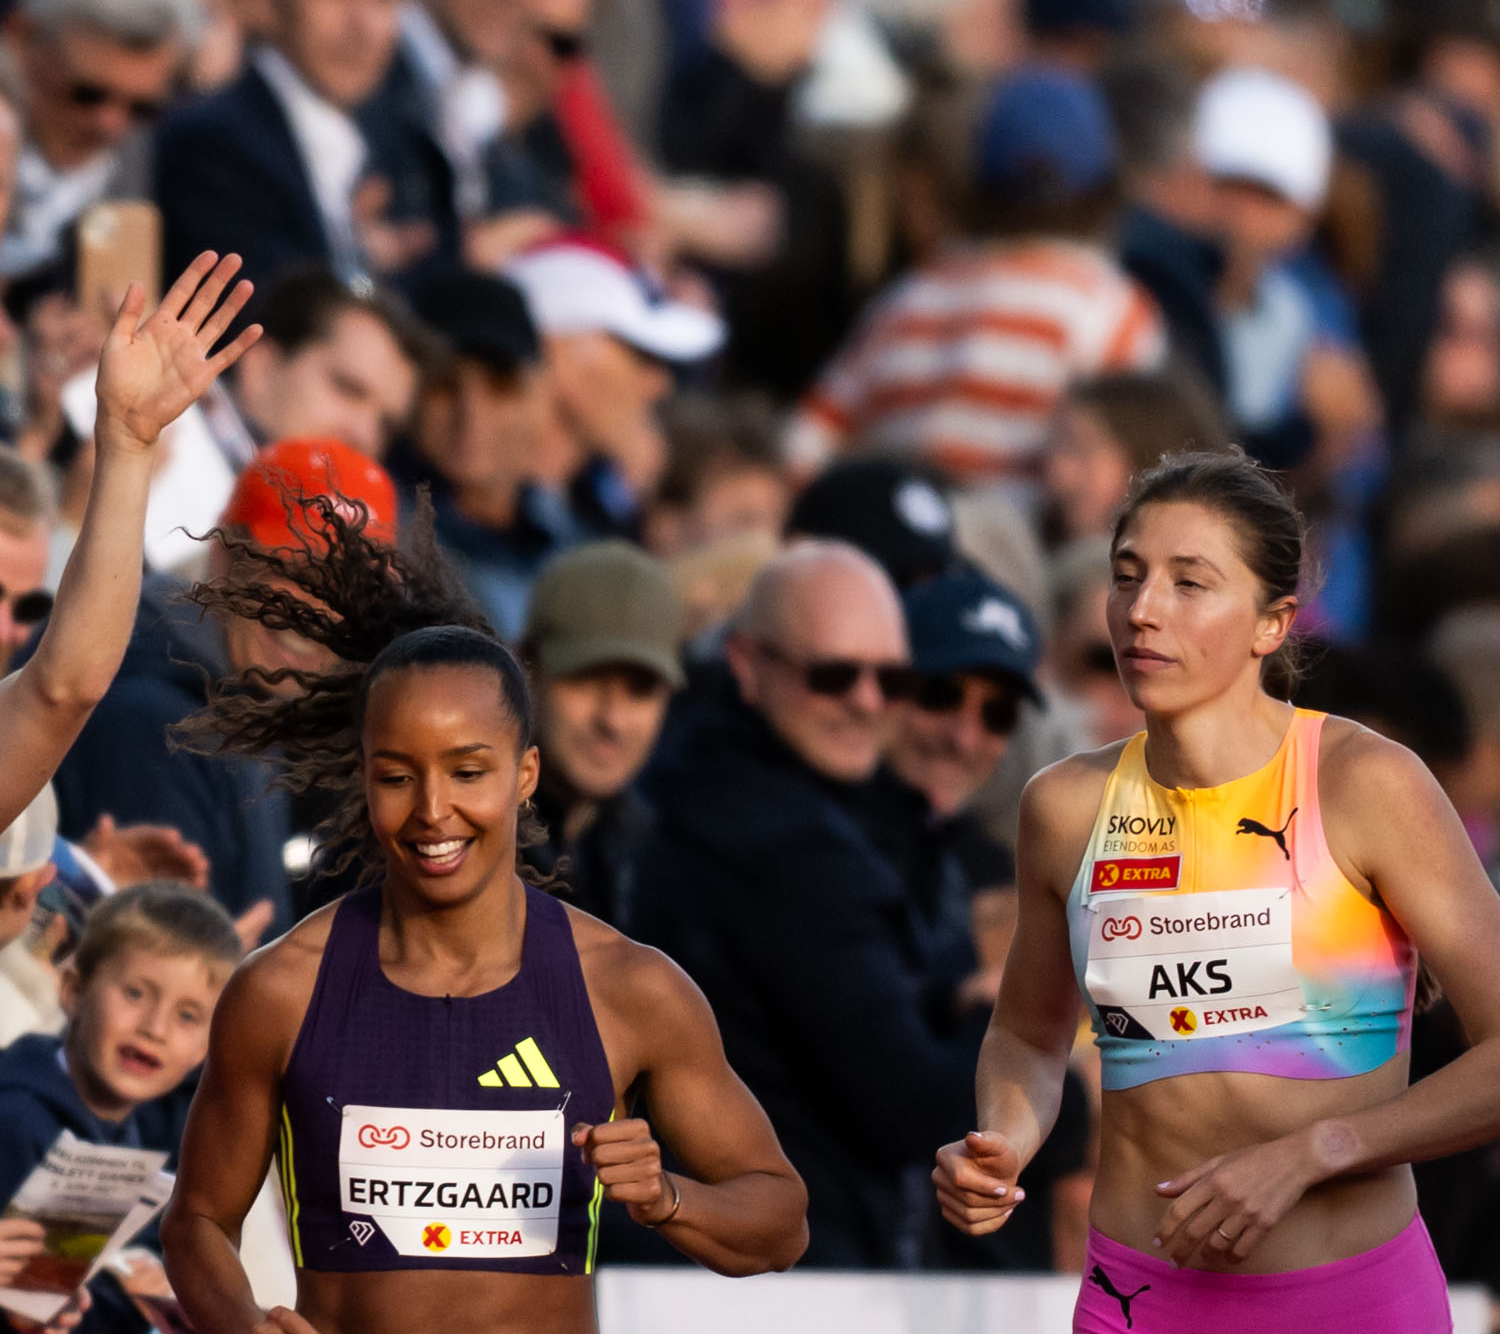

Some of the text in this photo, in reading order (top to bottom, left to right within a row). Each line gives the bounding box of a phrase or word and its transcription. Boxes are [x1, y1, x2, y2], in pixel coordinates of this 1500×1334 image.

[1107, 815, 1176, 836] SKOVLY
[1103, 840, 1176, 853] EIENDOM AS
[1122, 866, 1172, 881] EXTRA
[1150, 907, 1271, 935] Storebrand
[1148, 958, 1233, 1000] AKS
[1203, 1005, 1269, 1026] EXTRA
[420, 1129, 546, 1150] Storebrand
[349, 1177, 554, 1209] ERTZGAARD
[459, 1230, 523, 1245] EXTRA
